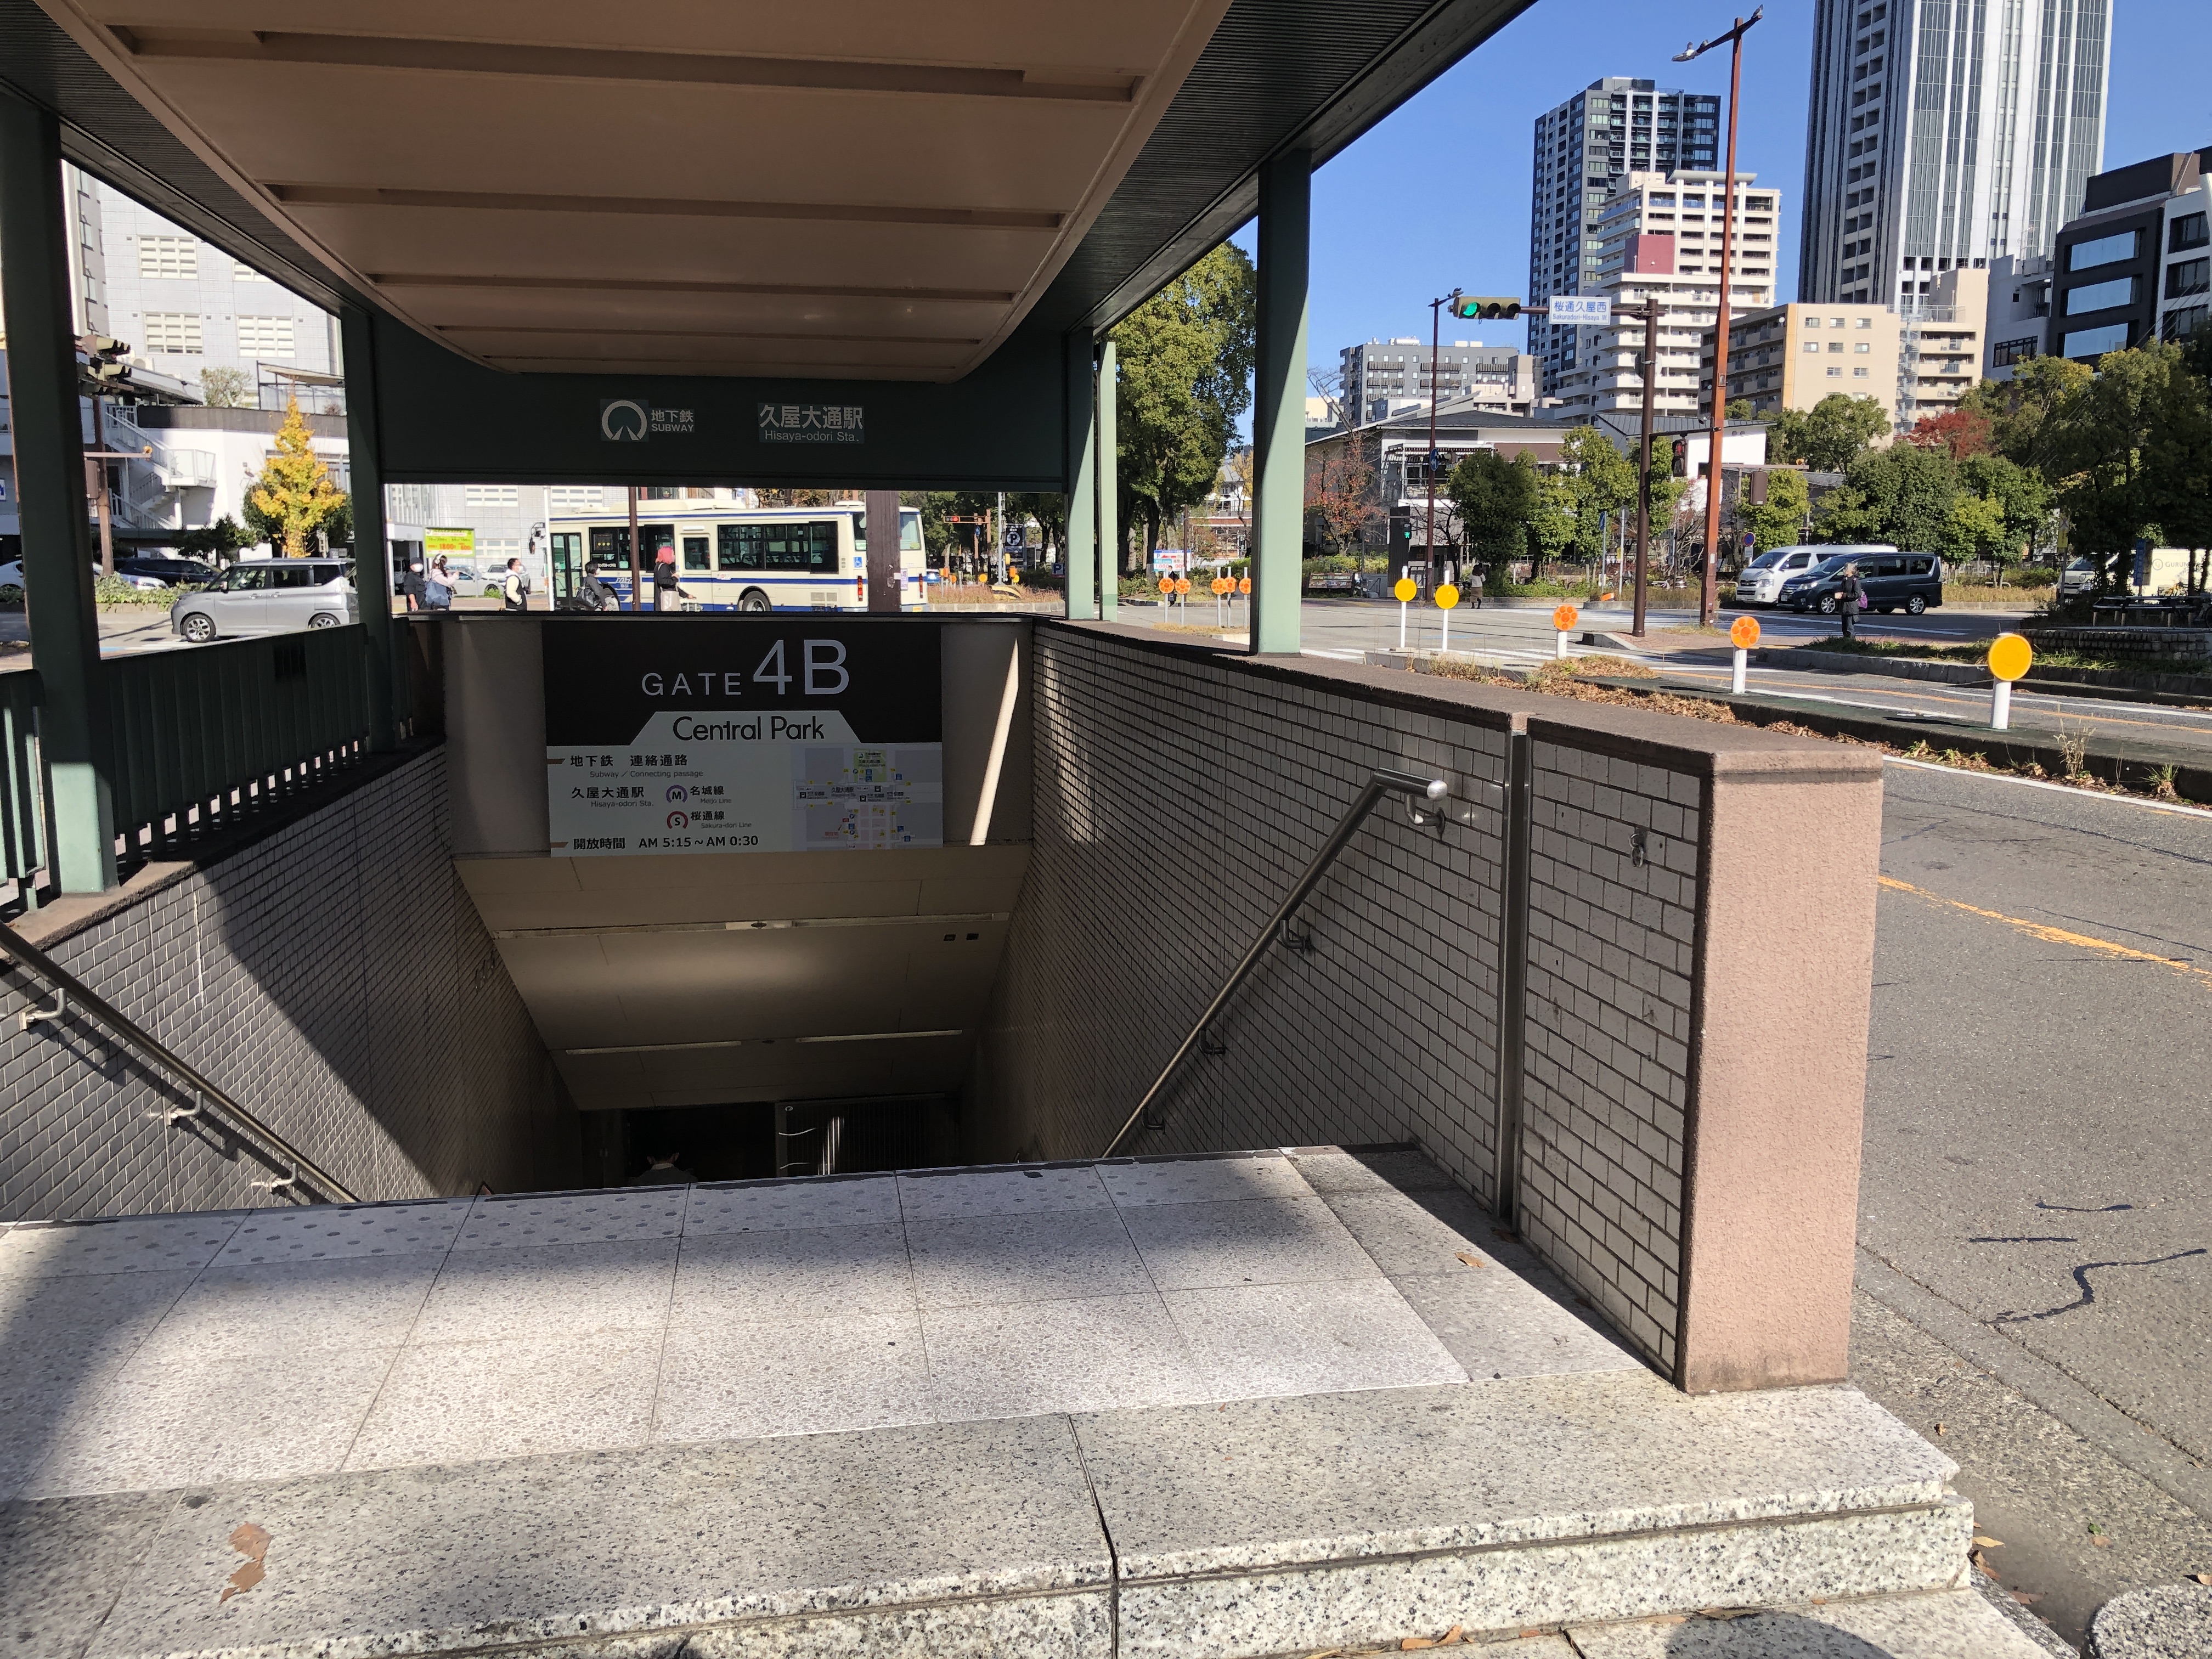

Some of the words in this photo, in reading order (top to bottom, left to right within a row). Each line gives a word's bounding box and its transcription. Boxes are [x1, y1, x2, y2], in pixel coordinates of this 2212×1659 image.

[1554, 301, 1607, 313] 桜通久屋西
[1553, 313, 1599, 321] Sakuradori-Hisaya
[651, 409, 694, 422] 地下鉄
[760, 405, 863, 429] 久屋大通駅
[651, 424, 694, 432] SUBWAY
[765, 430, 833, 442] Hisaya-odori
[837, 431, 860, 442] Sta.
[642, 673, 742, 696] GATE
[753, 639, 849, 695] 4B
[673, 716, 761, 741] Central
[771, 715, 825, 740] Park
[571, 755, 613, 767] 地下鉄
[630, 754, 687, 766] 連絡通路
[572, 786, 644, 799] 久屋大通駅
[672, 791, 682, 800] M
[690, 786, 724, 795] 名城線
[674, 817, 681, 826] S
[691, 810, 725, 821] 桜通線
[573, 837, 625, 849] 開放時間
[639, 838, 658, 848] AM
[730, 835, 759, 846] 0:30
